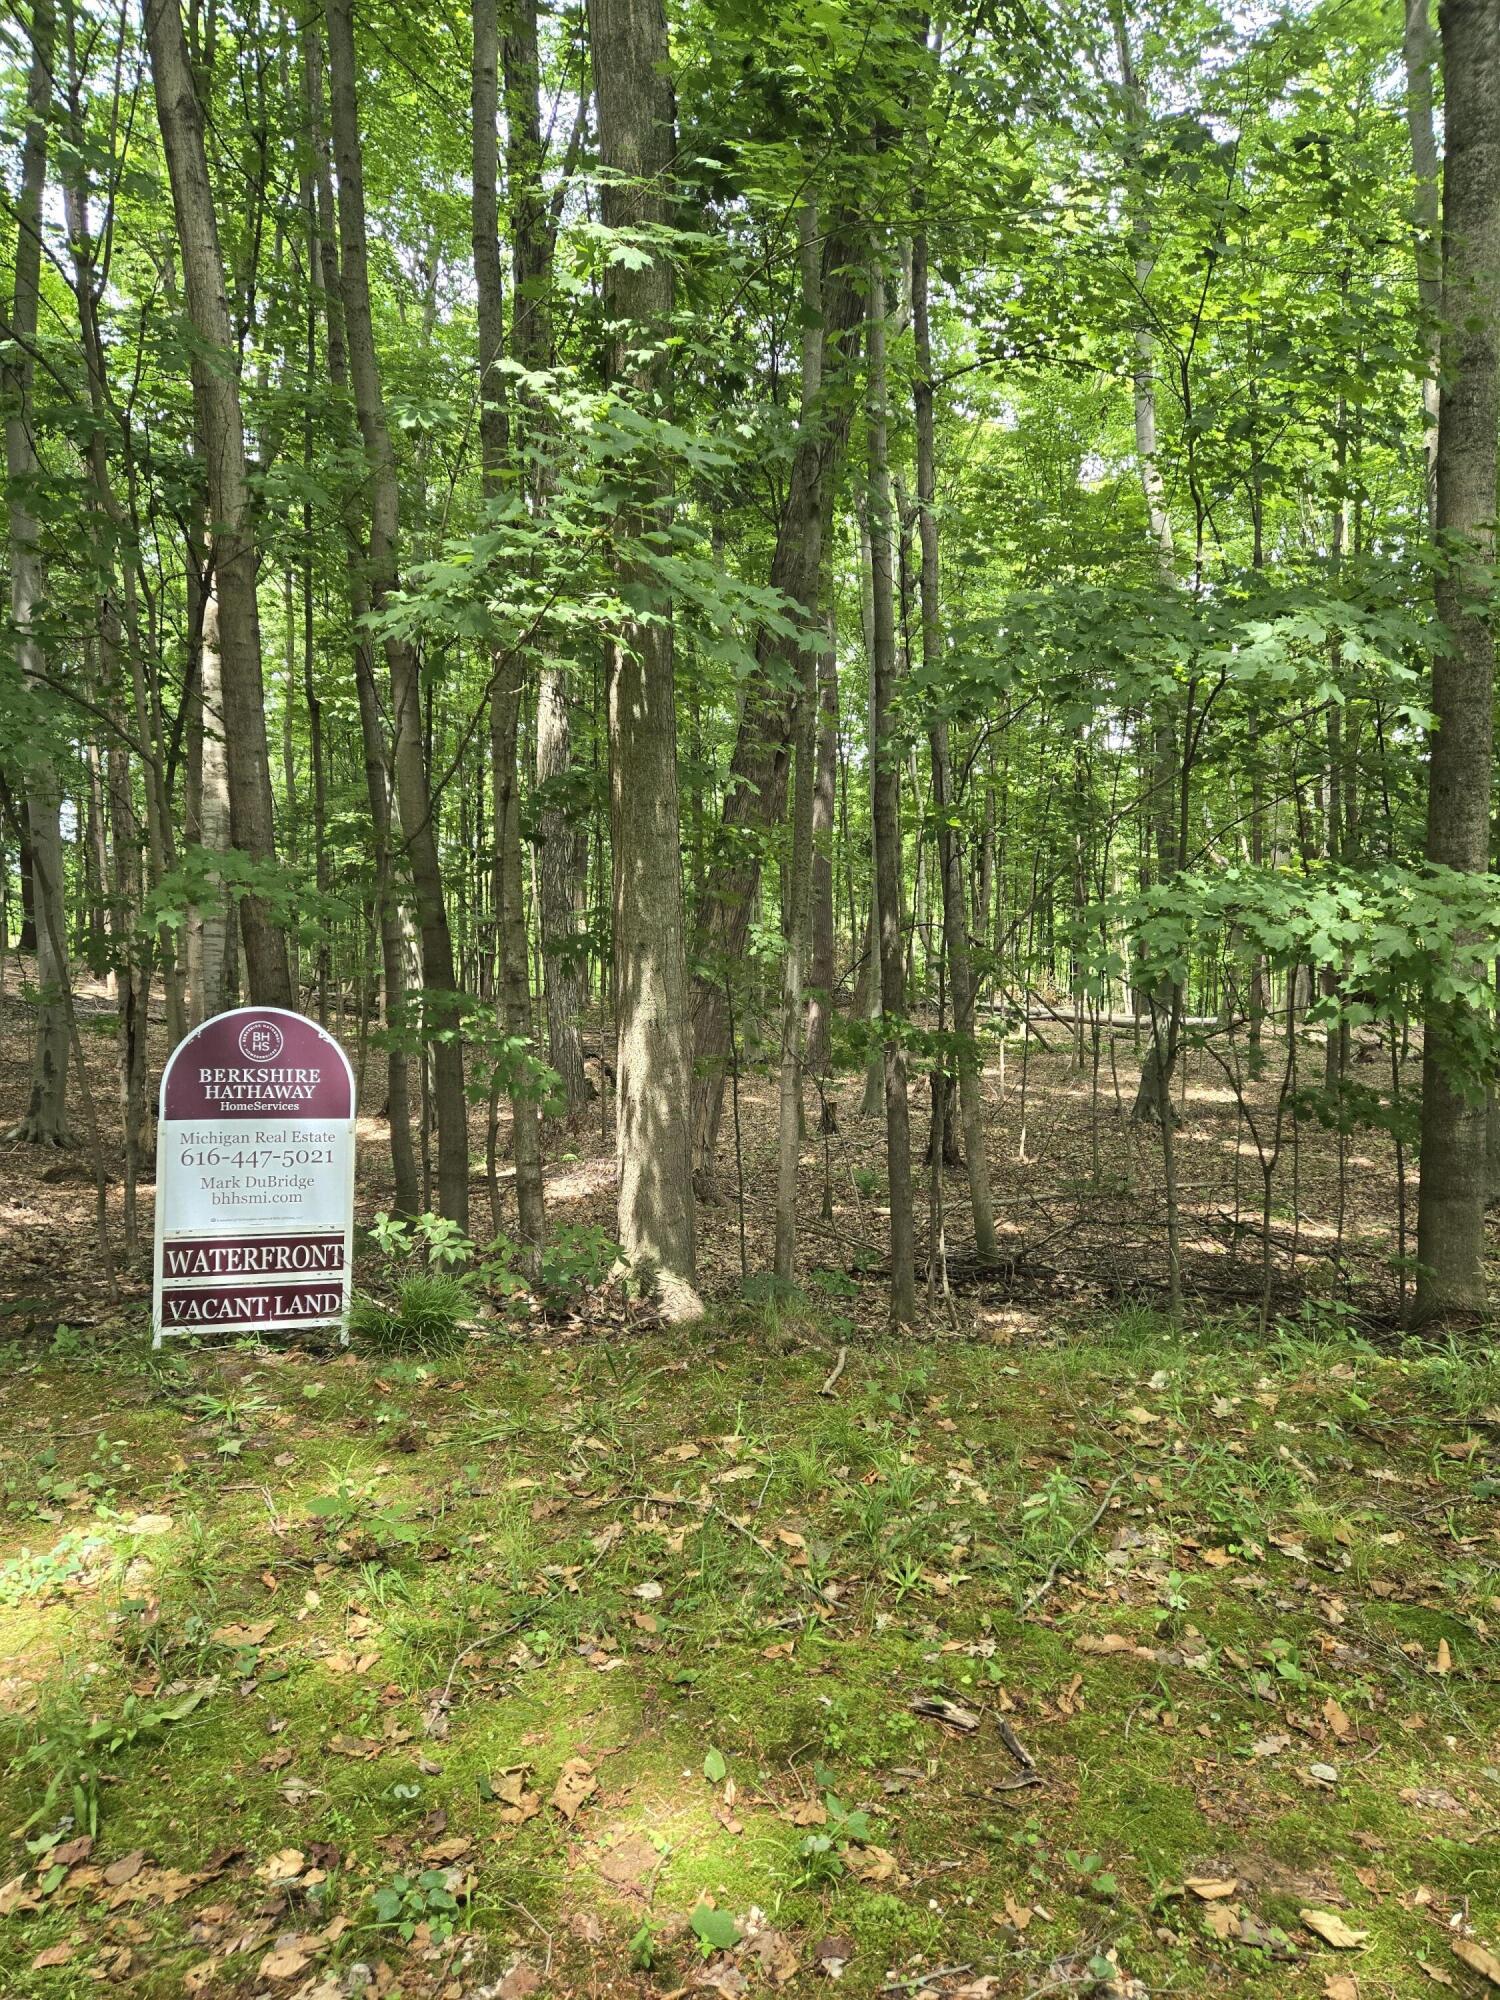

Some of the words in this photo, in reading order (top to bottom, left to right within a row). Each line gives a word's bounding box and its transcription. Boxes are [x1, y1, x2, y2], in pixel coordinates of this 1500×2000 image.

[252, 1031, 270, 1042] BH
[252, 1041, 270, 1052] HS
[199, 1068, 321, 1083] BERKSHIRE
[204, 1085, 316, 1100] HATHAWAY
[220, 1101, 299, 1111] HomeServices
[180, 1131, 250, 1147] Michigan
[255, 1130, 287, 1144] Real
[292, 1131, 336, 1143] Estate
[181, 1147, 334, 1169] 616-447-5021
[200, 1175, 241, 1190] Mark
[245, 1174, 315, 1190] DuBridge
[212, 1191, 303, 1206] bhhsmi.com
[167, 1243, 344, 1275] WATERFRONT
[167, 1296, 269, 1321] VACANT
[274, 1293, 341, 1316] LAND
